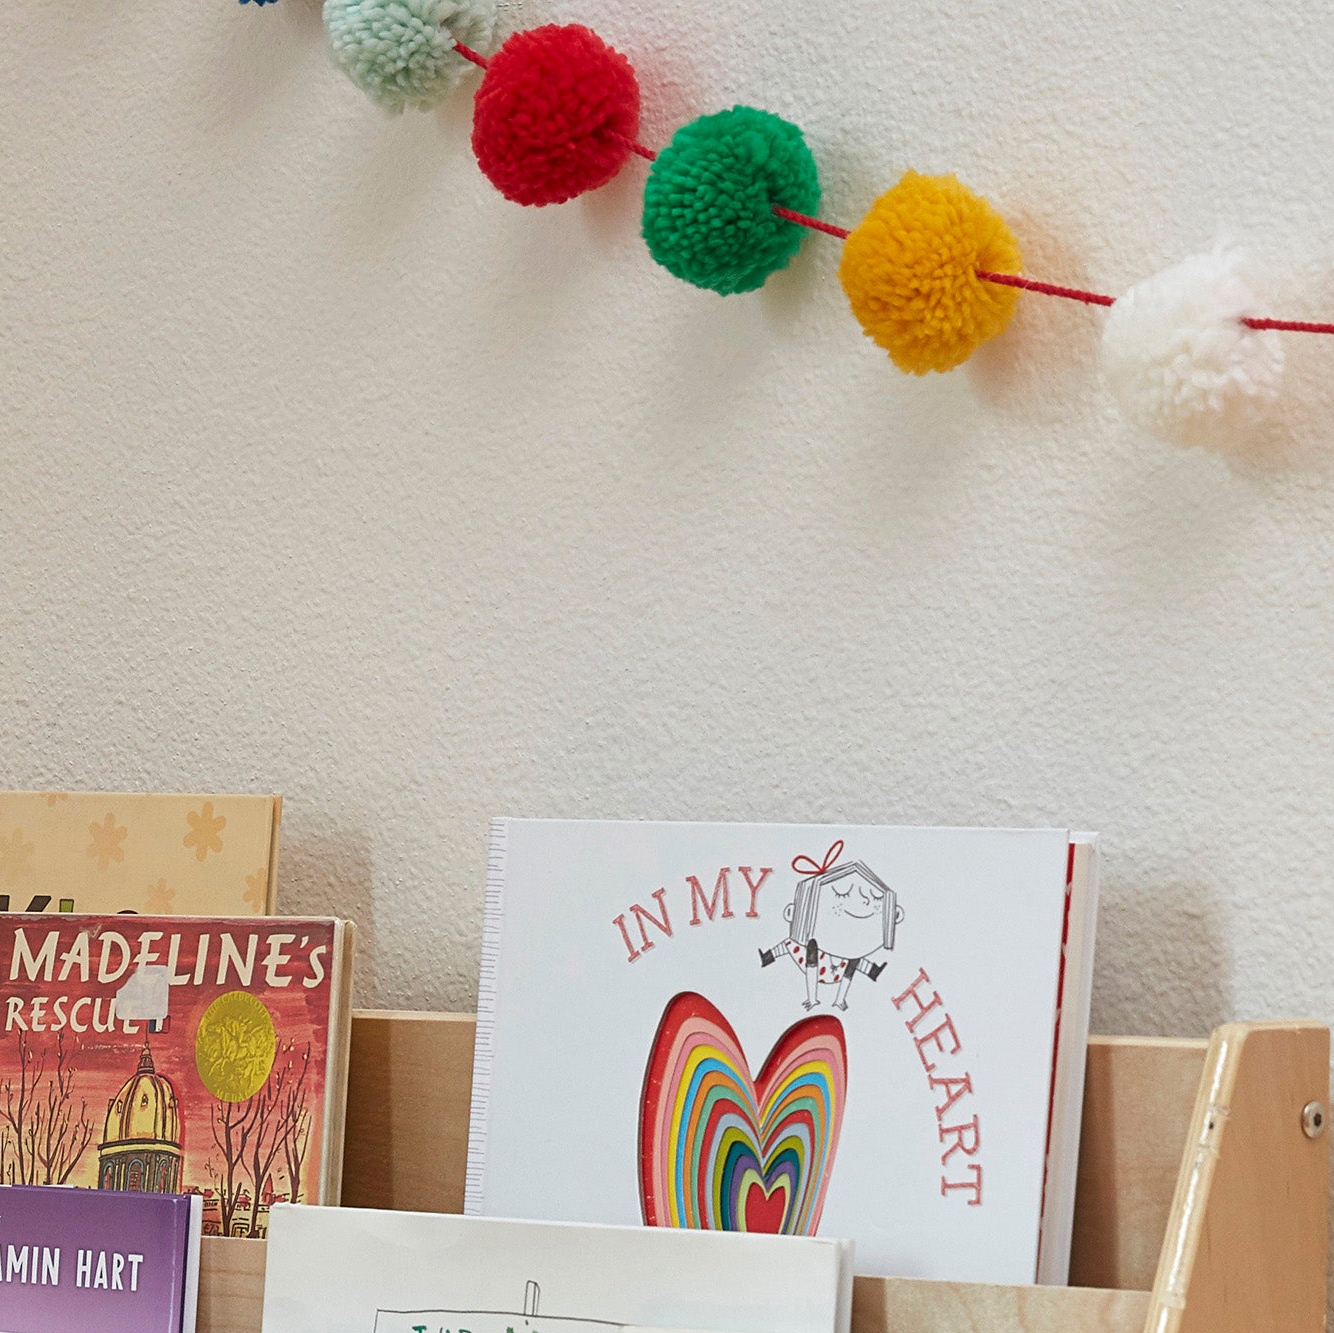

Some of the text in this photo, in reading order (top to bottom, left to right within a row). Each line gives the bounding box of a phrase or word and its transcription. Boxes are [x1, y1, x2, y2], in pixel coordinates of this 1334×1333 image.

[612, 866, 983, 1207] IN MY HEART
[75, 1249, 144, 1292] HART
